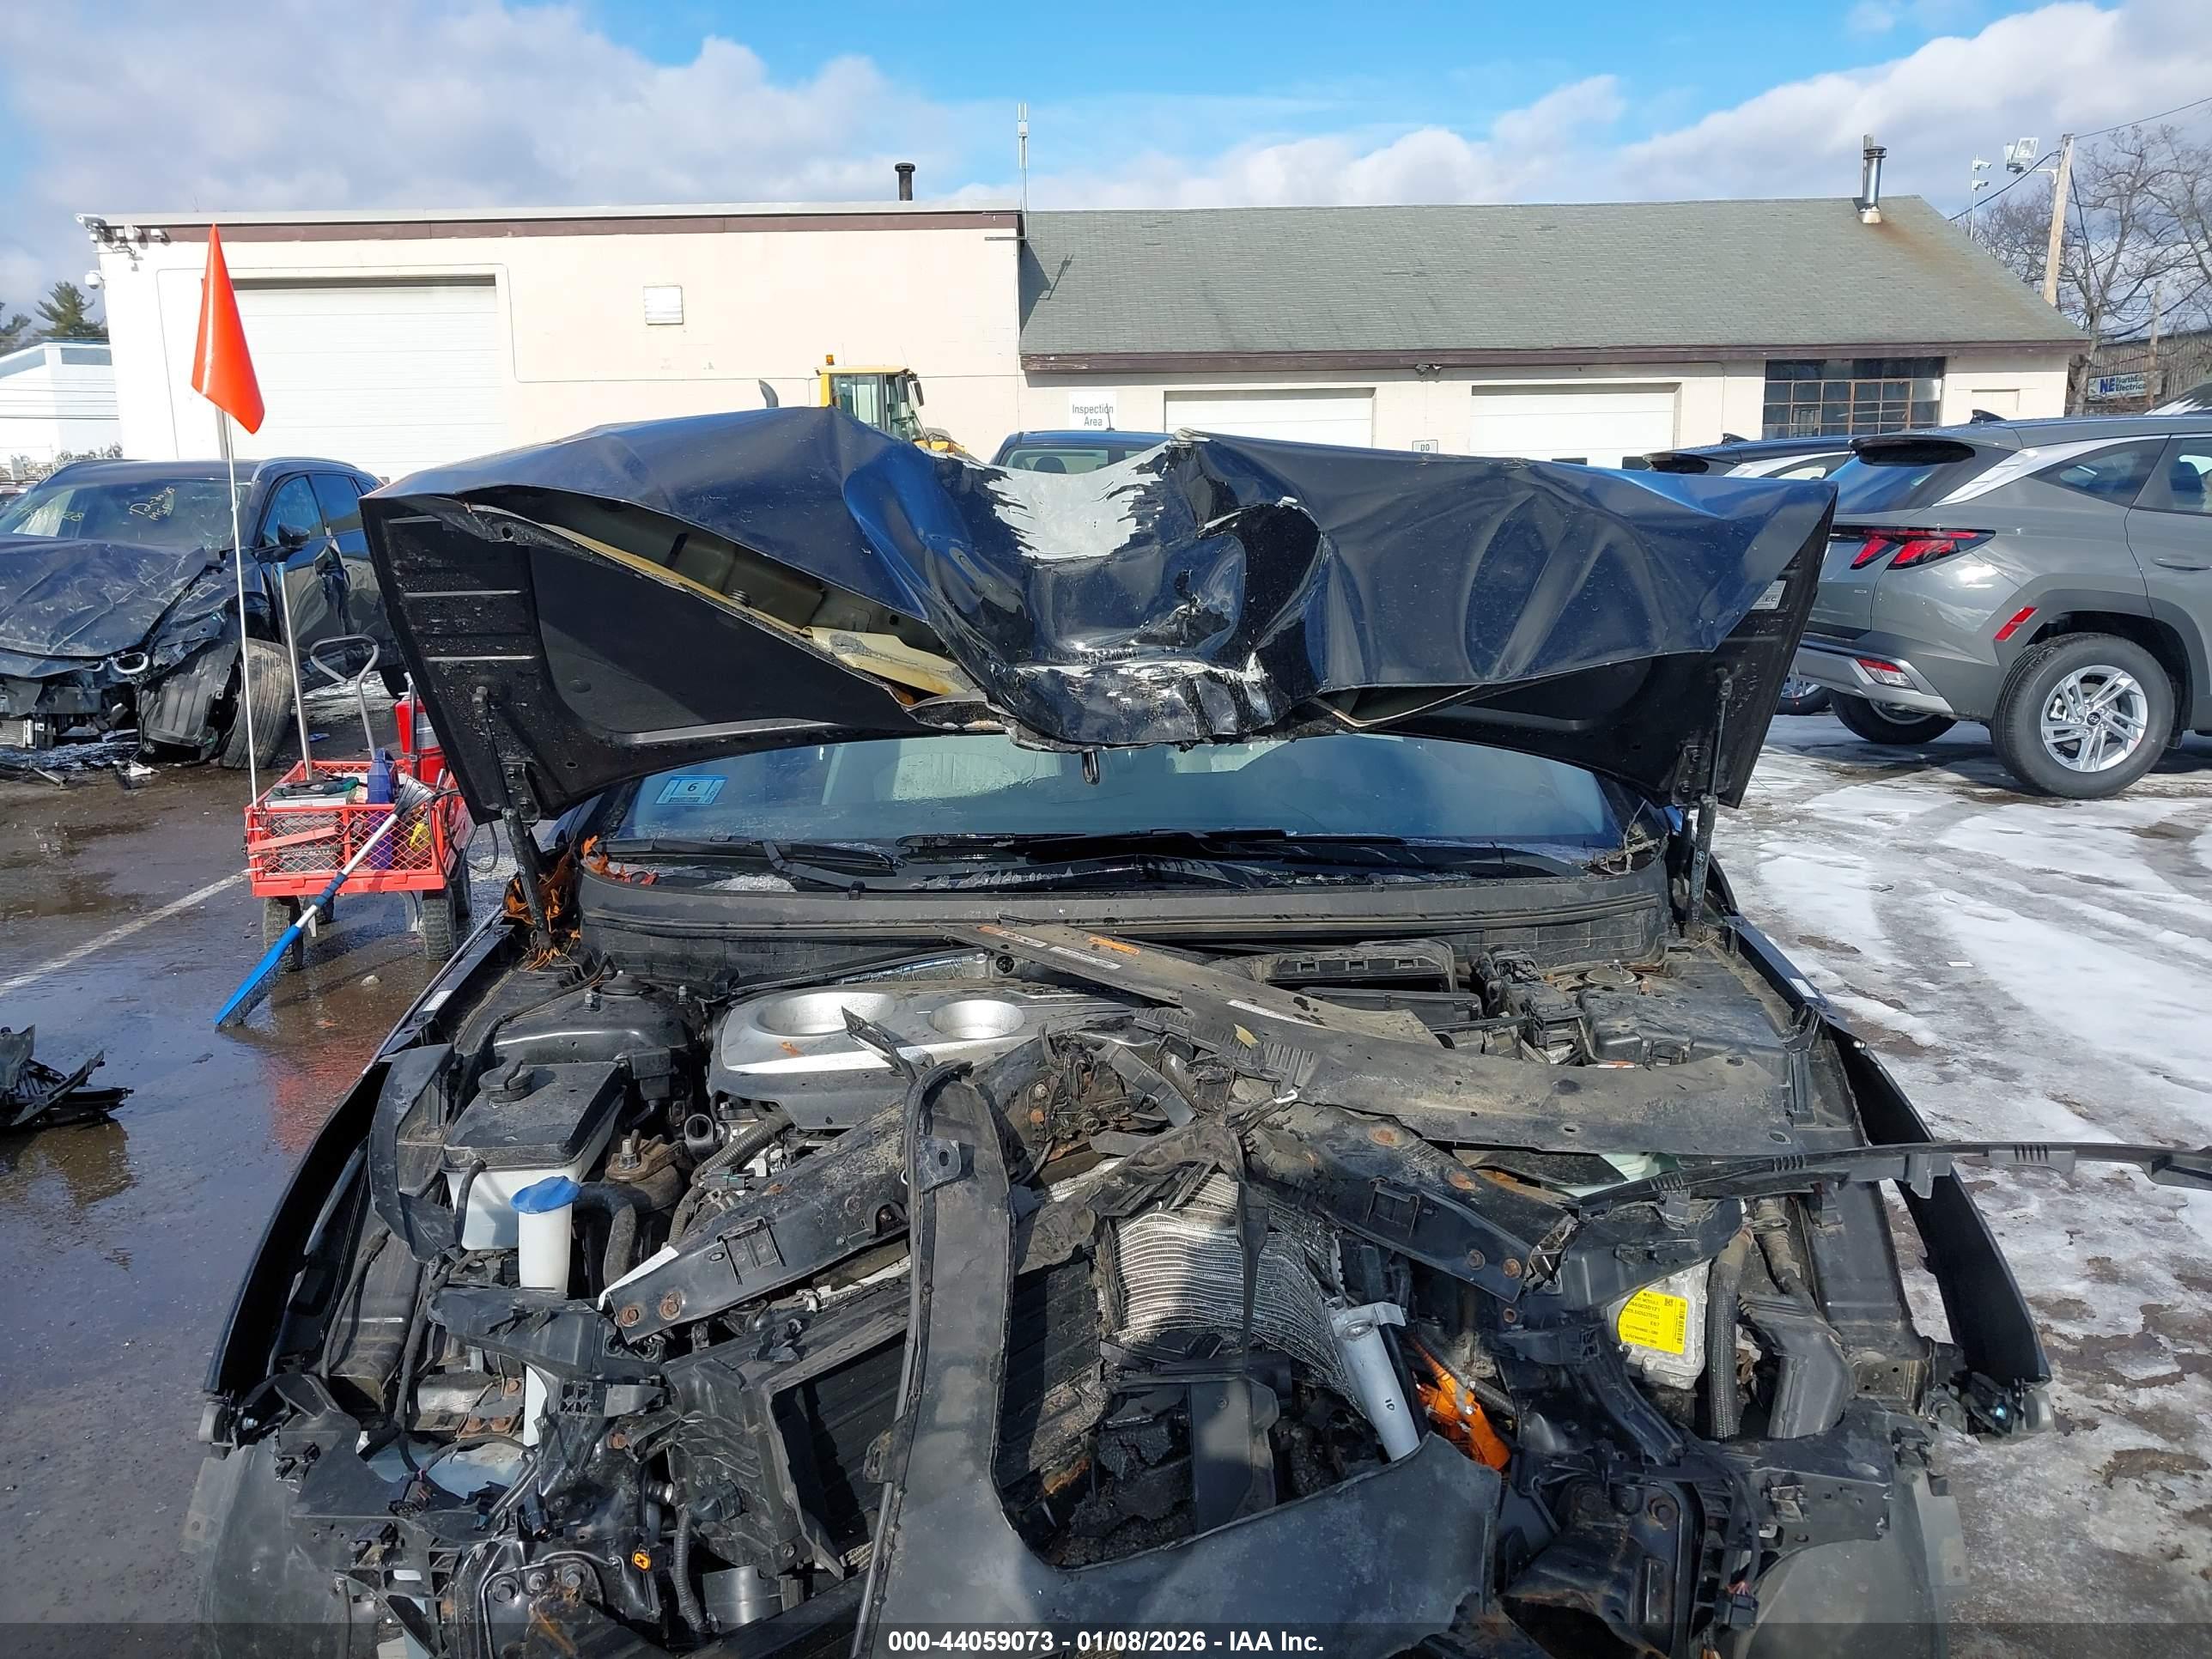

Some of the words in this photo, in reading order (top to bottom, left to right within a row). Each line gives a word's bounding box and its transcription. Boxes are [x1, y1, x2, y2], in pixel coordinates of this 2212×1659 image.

[1073, 403, 1113, 416] Inspection
[1085, 416, 1103, 426] Area
[688, 782, 698, 792] 6
